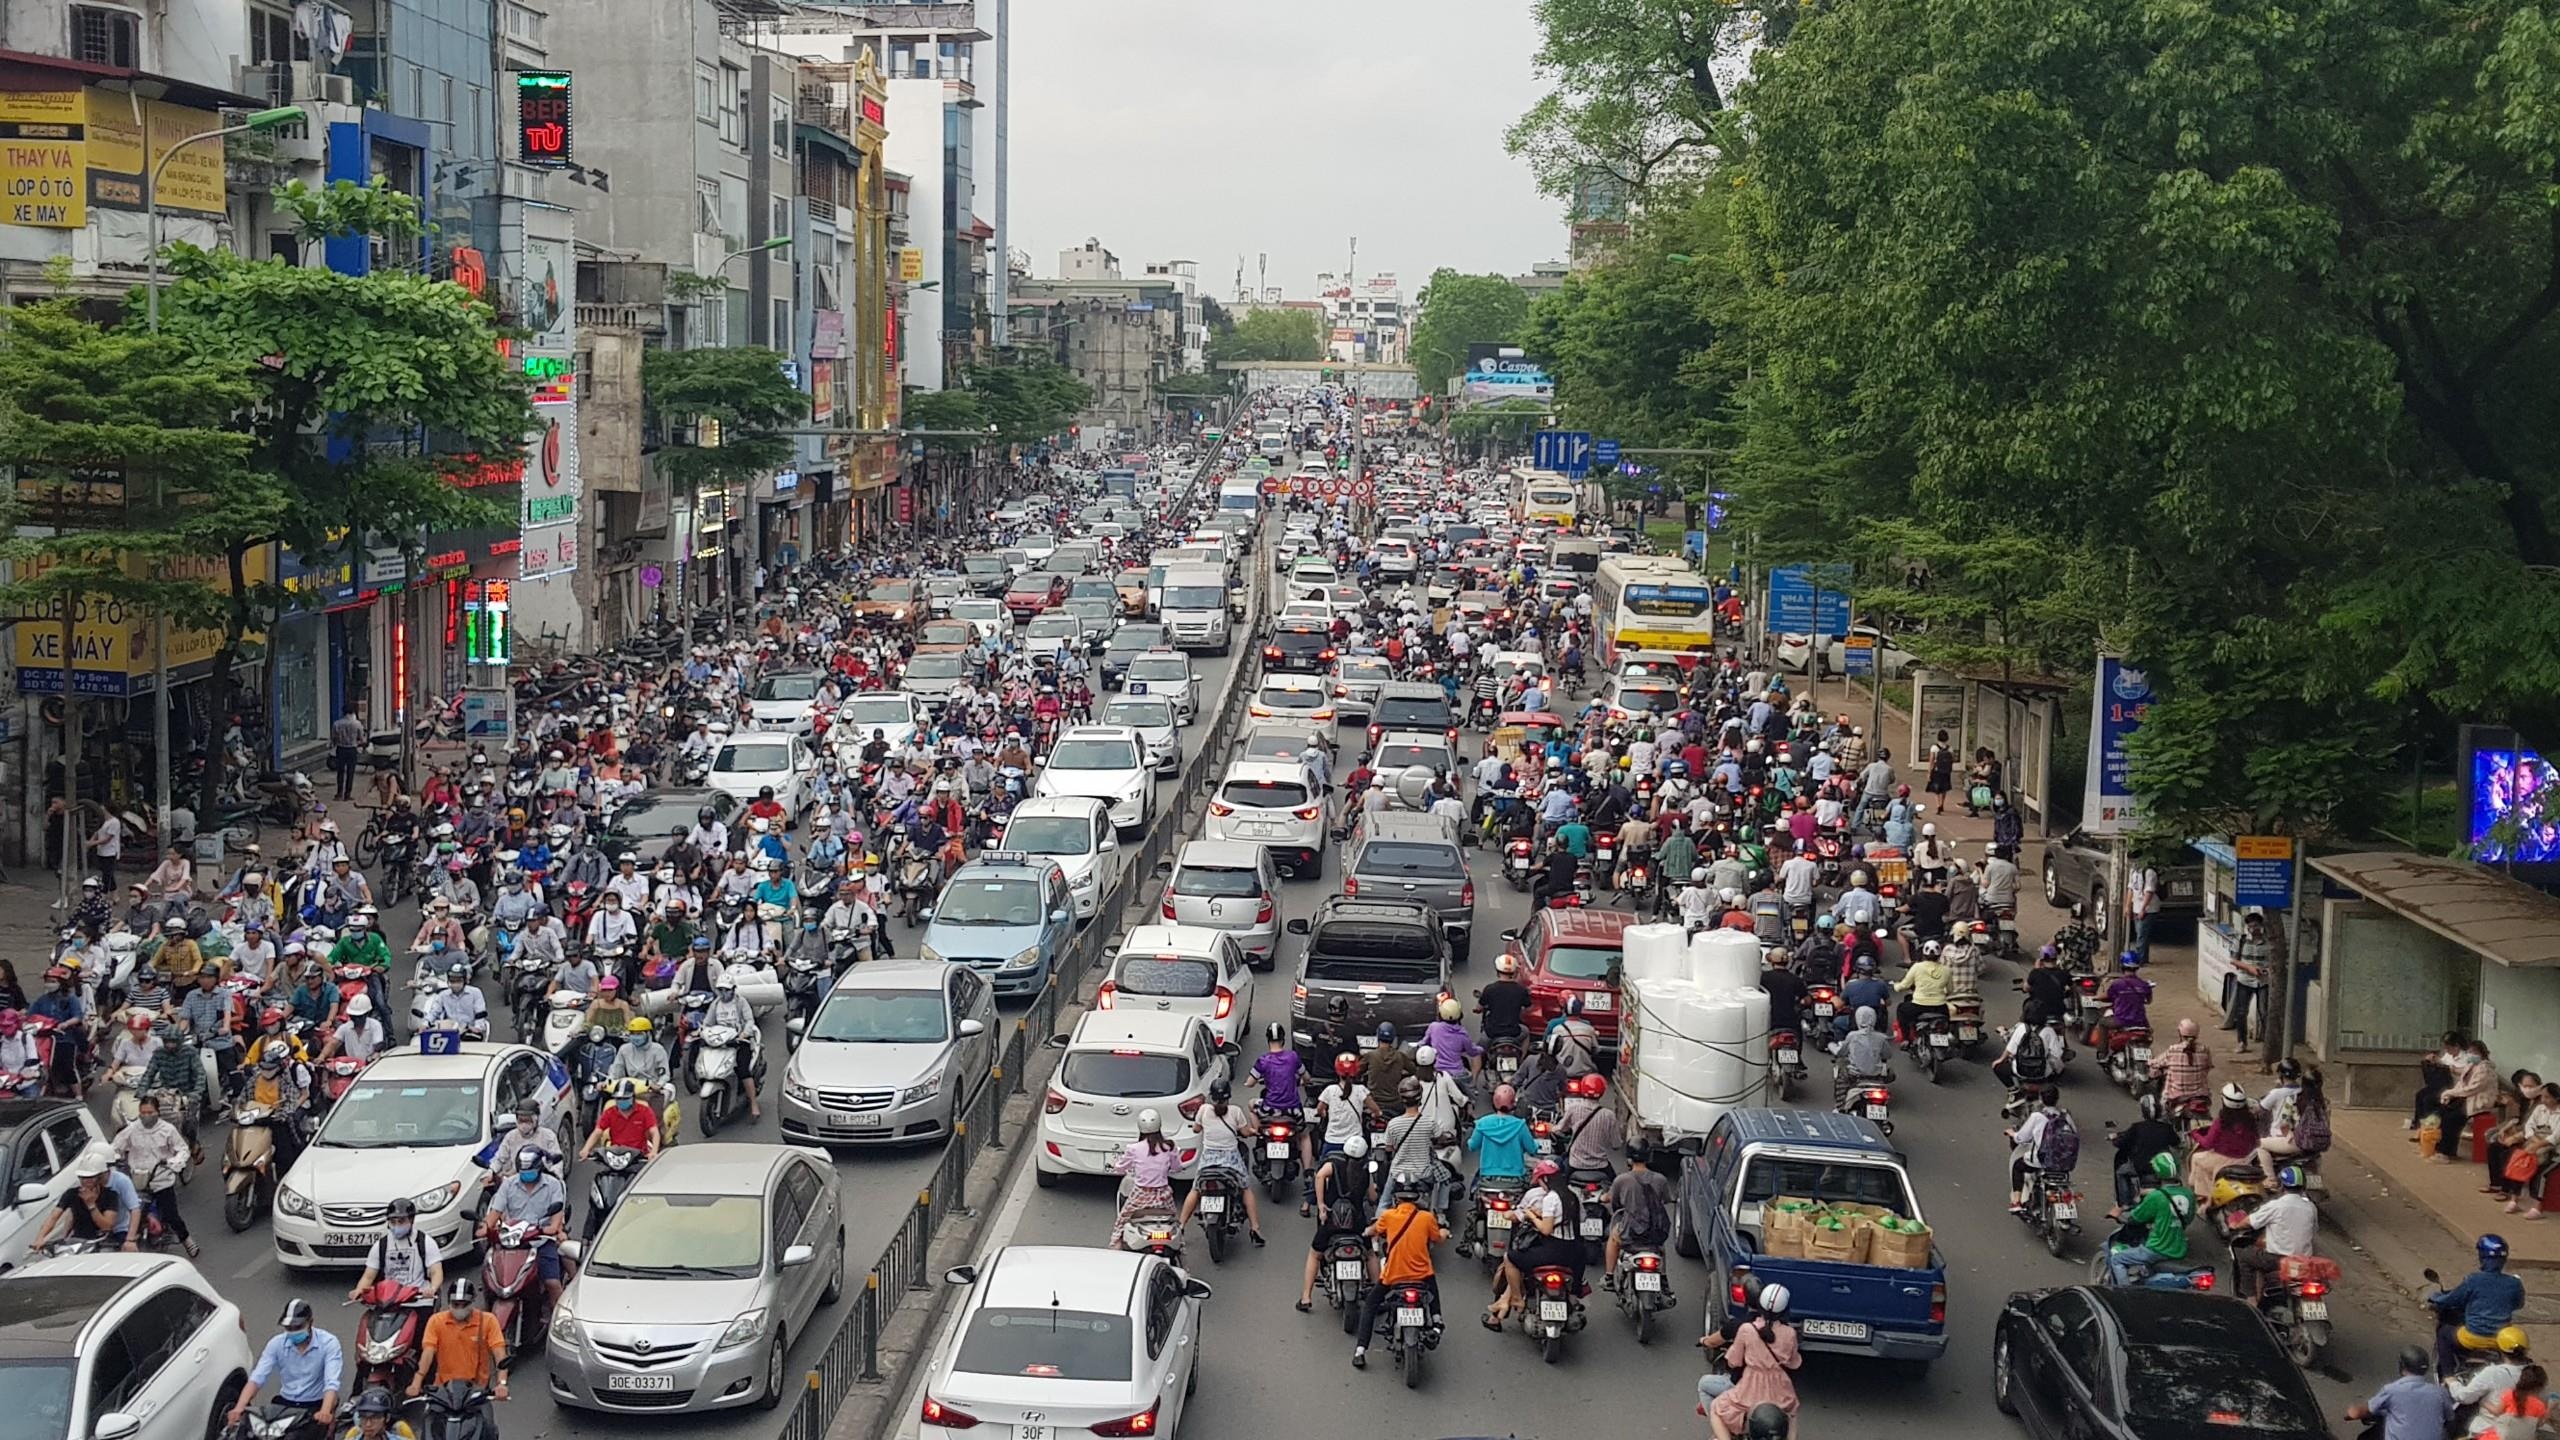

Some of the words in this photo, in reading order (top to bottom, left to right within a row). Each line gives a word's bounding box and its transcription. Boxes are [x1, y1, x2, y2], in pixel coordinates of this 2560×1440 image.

[526, 121, 564, 151] TỪ
[7, 147, 48, 167] THAY
[50, 145, 72, 168] VÁ
[39, 175, 50, 197] Ô
[53, 176, 73, 197] TÔ
[14, 204, 32, 221] XE
[36, 201, 67, 222] MÁY
[1499, 360, 1541, 375] Casper
[32, 632, 60, 658] XE
[1022, 1427, 1045, 1440] 30F
